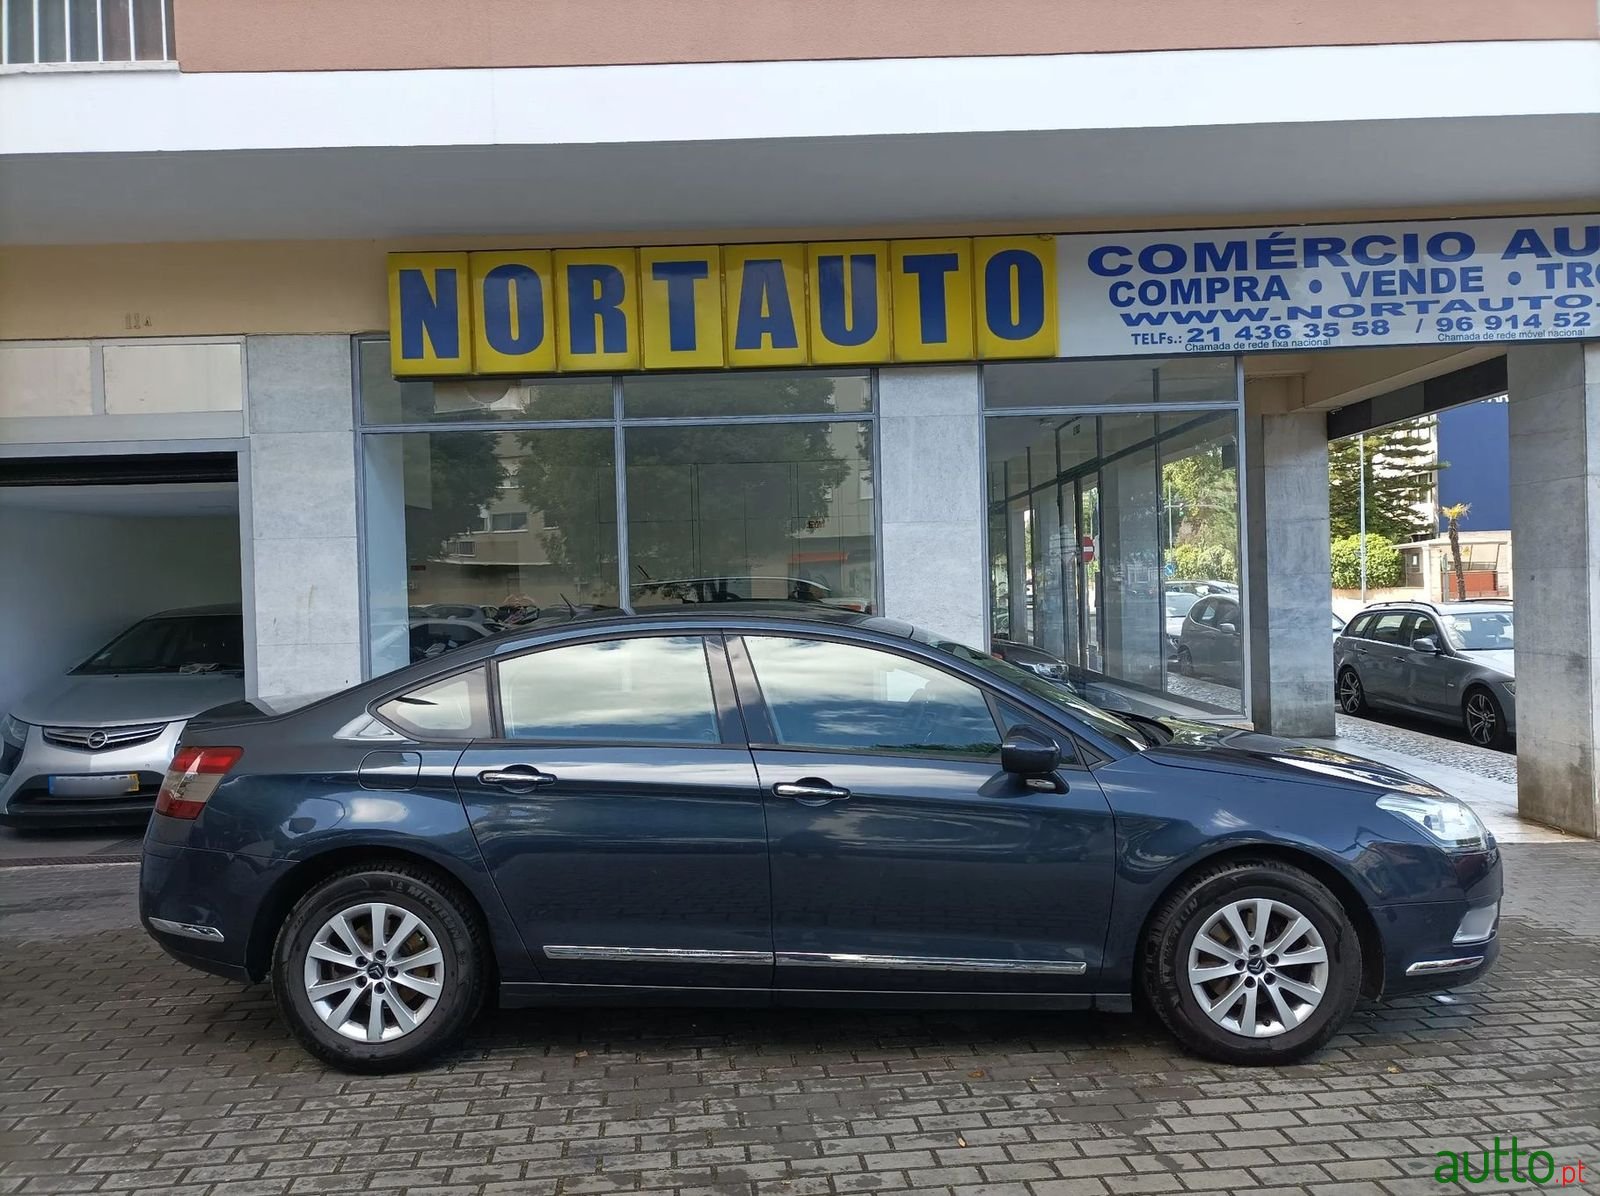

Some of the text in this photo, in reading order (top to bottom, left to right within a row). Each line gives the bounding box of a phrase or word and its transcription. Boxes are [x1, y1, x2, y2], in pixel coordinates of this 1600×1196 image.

[1087, 231, 1475, 277] COMÉRCIO
[1109, 260, 1600, 308] COMPRA VENDE TR
[399, 249, 1045, 359] NORTAUTO
[1185, 337, 1331, 352] Chamada de rede fixa nacional
[1187, 326, 1221, 343] 21
[1235, 324, 1292, 341] 436
[1303, 322, 1340, 339] 35
[1351, 319, 1391, 336] 58
[1436, 316, 1474, 332] 96
[1484, 313, 1542, 331] 914
[1552, 311, 1592, 328] 52
[1437, 328, 1585, 342] Chamada de rede móvel nacional
